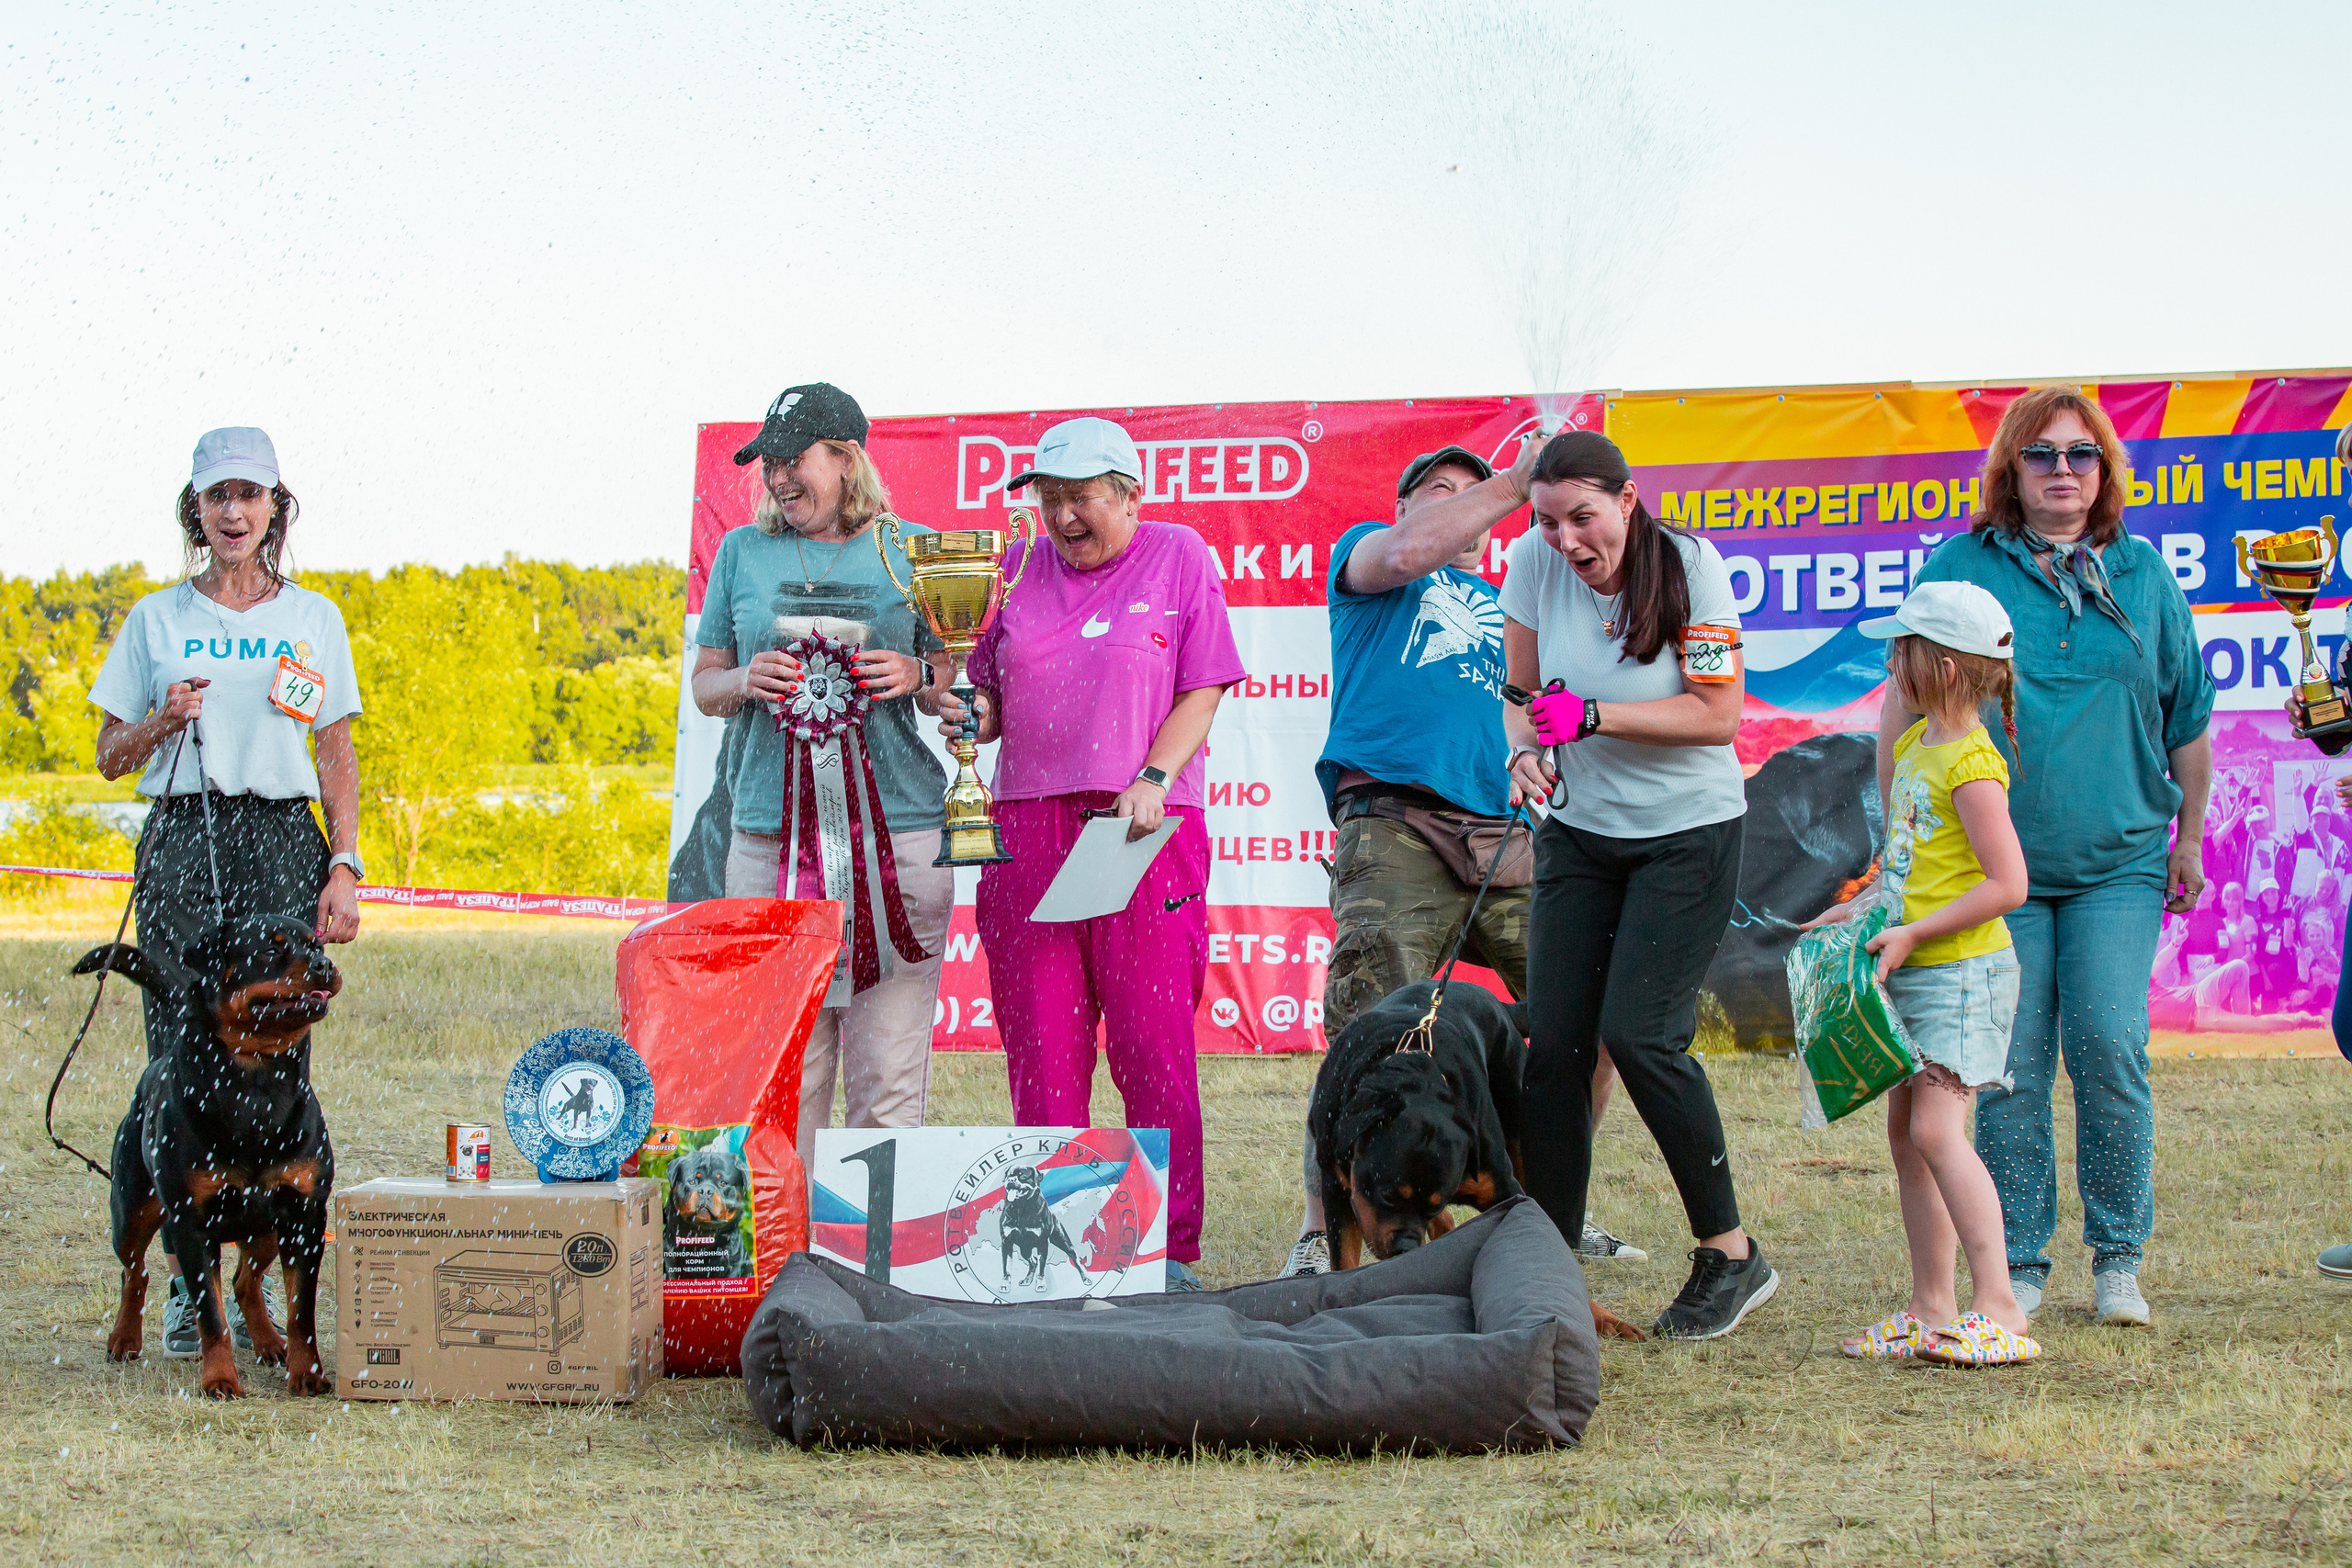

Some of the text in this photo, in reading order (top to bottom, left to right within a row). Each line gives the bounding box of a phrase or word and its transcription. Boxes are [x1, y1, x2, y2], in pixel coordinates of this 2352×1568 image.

[1281, 544, 1312, 579] И
[1687, 629, 1729, 640] PROFIFEED
[185, 637, 296, 660] PUMA
[286, 676, 314, 707] 49
[1208, 782, 1272, 807] ИЮ
[1208, 830, 1339, 865] ЦЕВ!!!
[457, 895, 516, 909] ТРАПЕЗА
[1169, 896, 1201, 904] NIKE
[561, 901, 621, 916] ТРАПЕЗА
[839, 1138, 897, 1285] 1
[948, 1139, 1136, 1275] РОТВЕЙЛЕР КЛУБ РОССИИ
[348, 1211, 446, 1222] ЭЛЕКТРИЧЕСКАЯ
[348, 1228, 563, 1240] МНОГОФУНКЦИОНАЛЬНАЯ МИНИ-ПЕЧЬ
[675, 1236, 715, 1245] PROFIFEED
[506, 1382, 600, 1392] WWW.GFGRIL.RU
